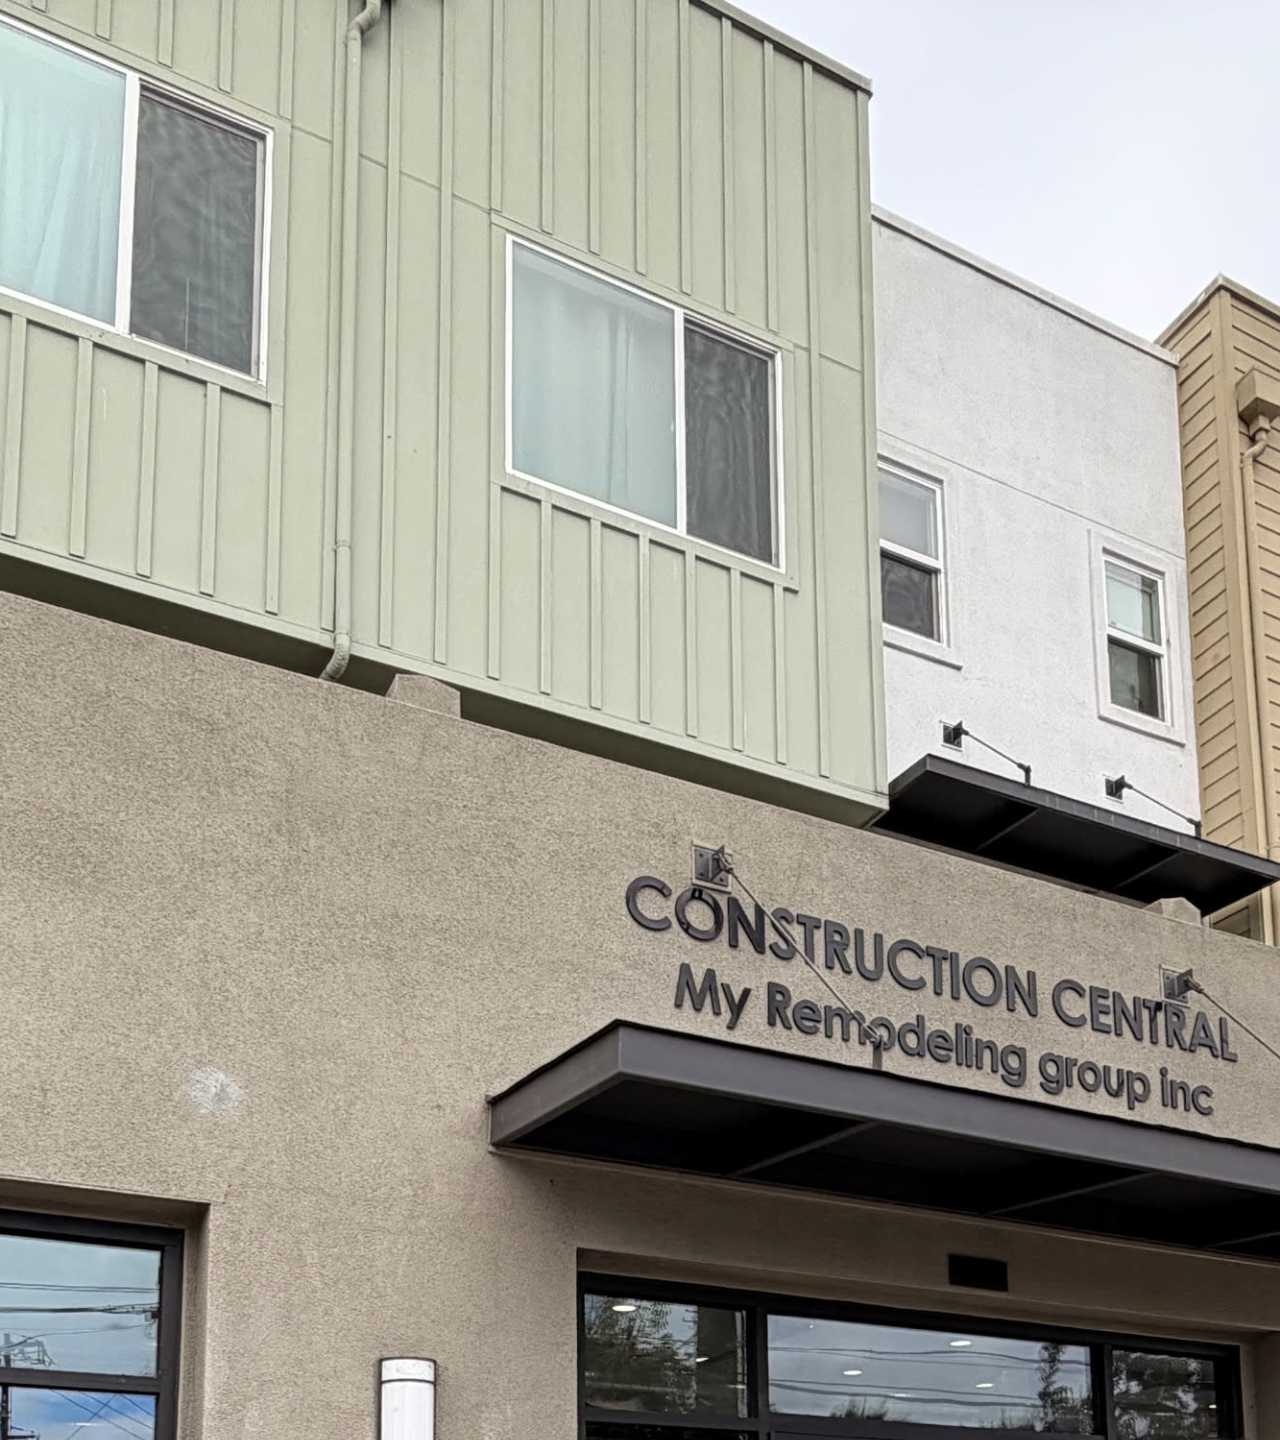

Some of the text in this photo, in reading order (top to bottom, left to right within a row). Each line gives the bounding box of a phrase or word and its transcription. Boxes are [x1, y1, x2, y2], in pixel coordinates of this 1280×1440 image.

[625, 875, 1238, 1063] CONSTRUCTION CENTRAL
[673, 962, 1215, 1116] My Remodeling group inc
